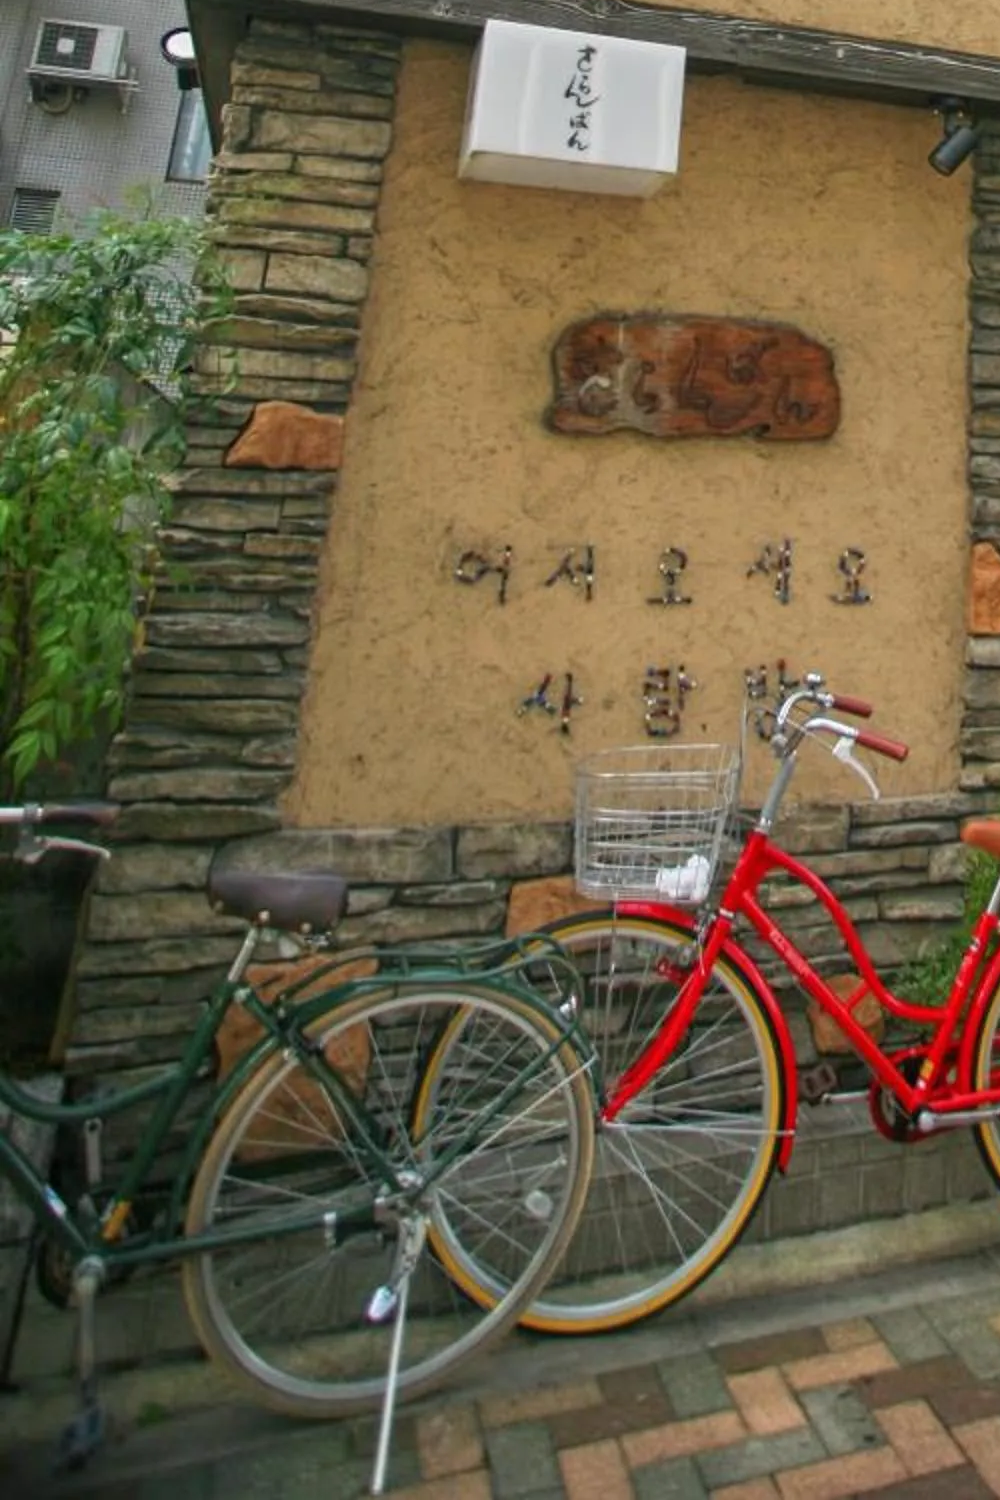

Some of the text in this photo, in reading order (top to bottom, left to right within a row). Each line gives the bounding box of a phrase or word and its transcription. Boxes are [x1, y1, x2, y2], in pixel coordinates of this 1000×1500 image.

[564, 45, 600, 151] さらんばん
